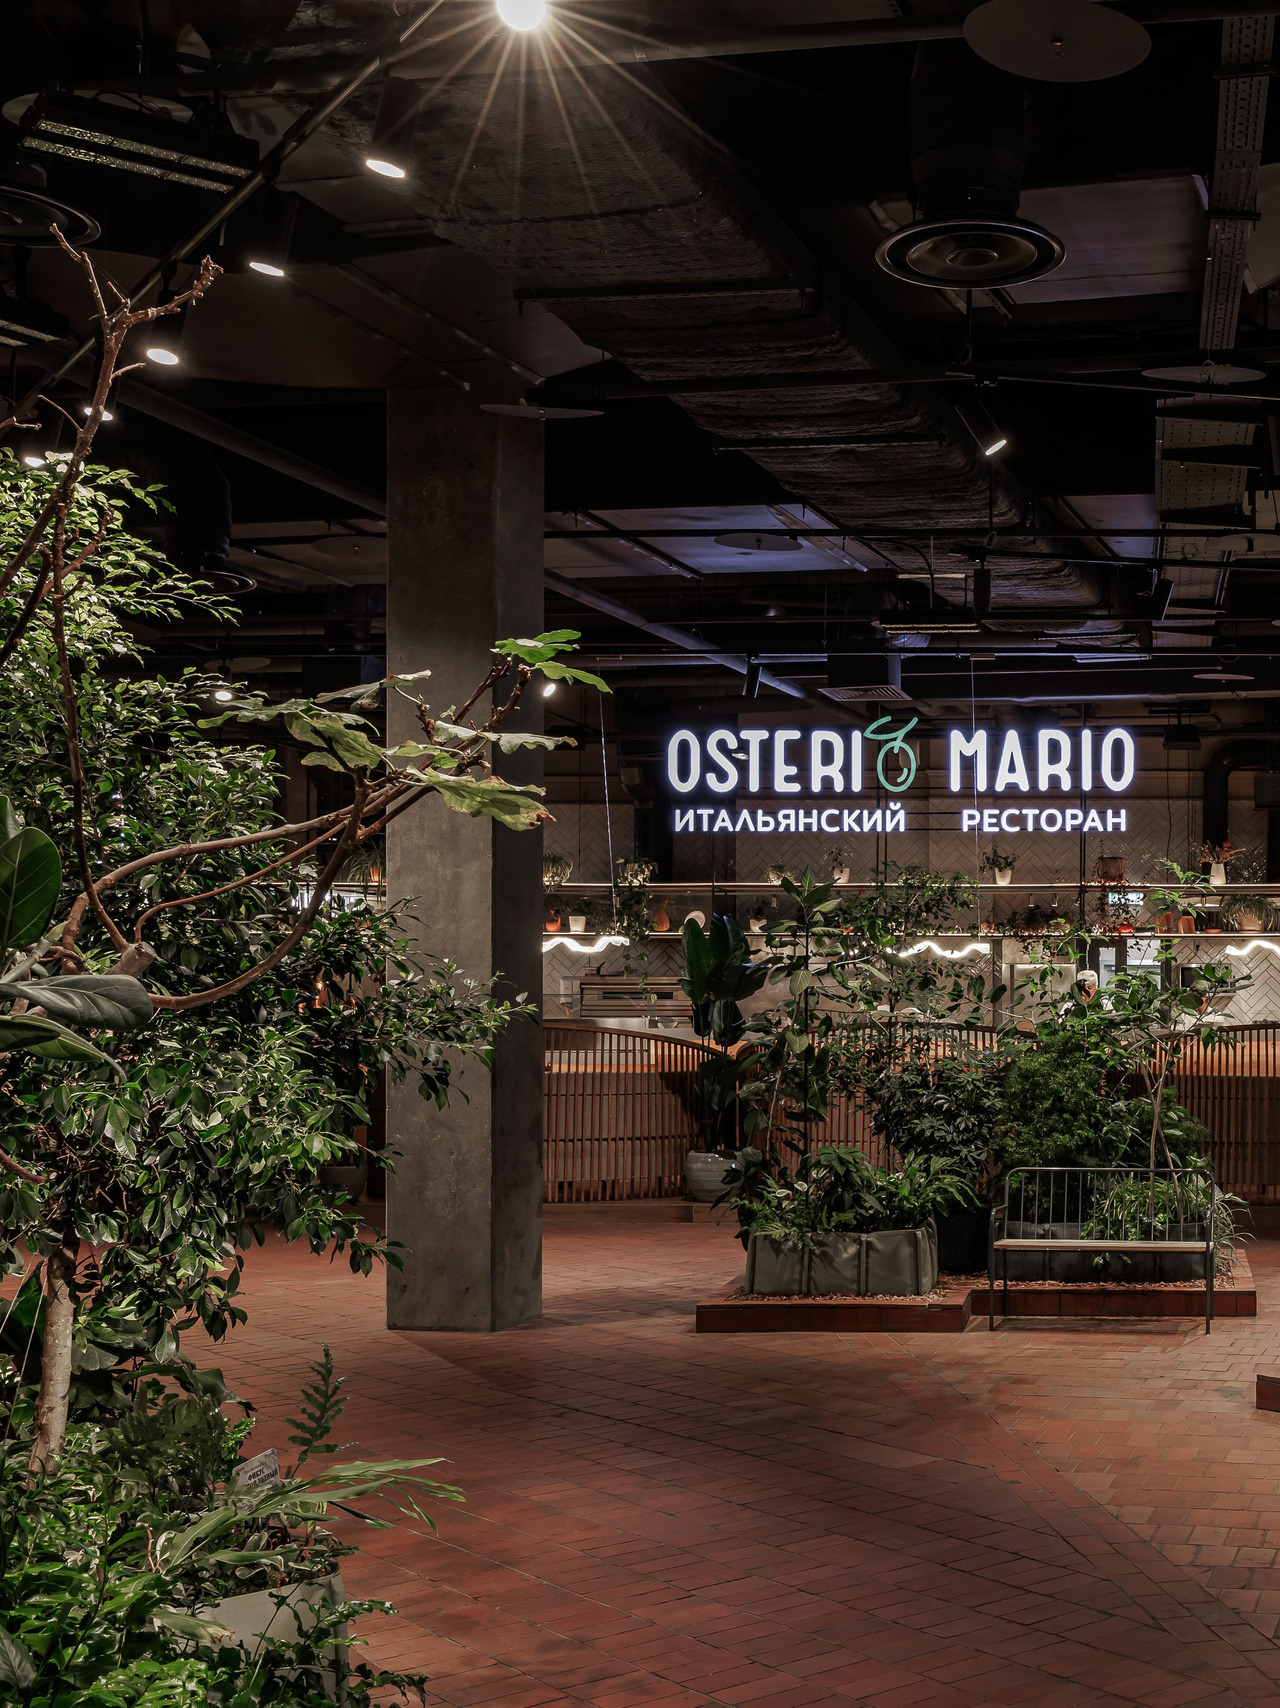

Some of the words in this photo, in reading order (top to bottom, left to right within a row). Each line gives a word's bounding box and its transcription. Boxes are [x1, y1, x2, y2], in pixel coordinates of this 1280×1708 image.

[949, 728, 1135, 793] MARIO
[674, 802, 906, 833] ИТАЛЬЯНСКИЙ
[961, 808, 1128, 833] РЕСТОРАН
